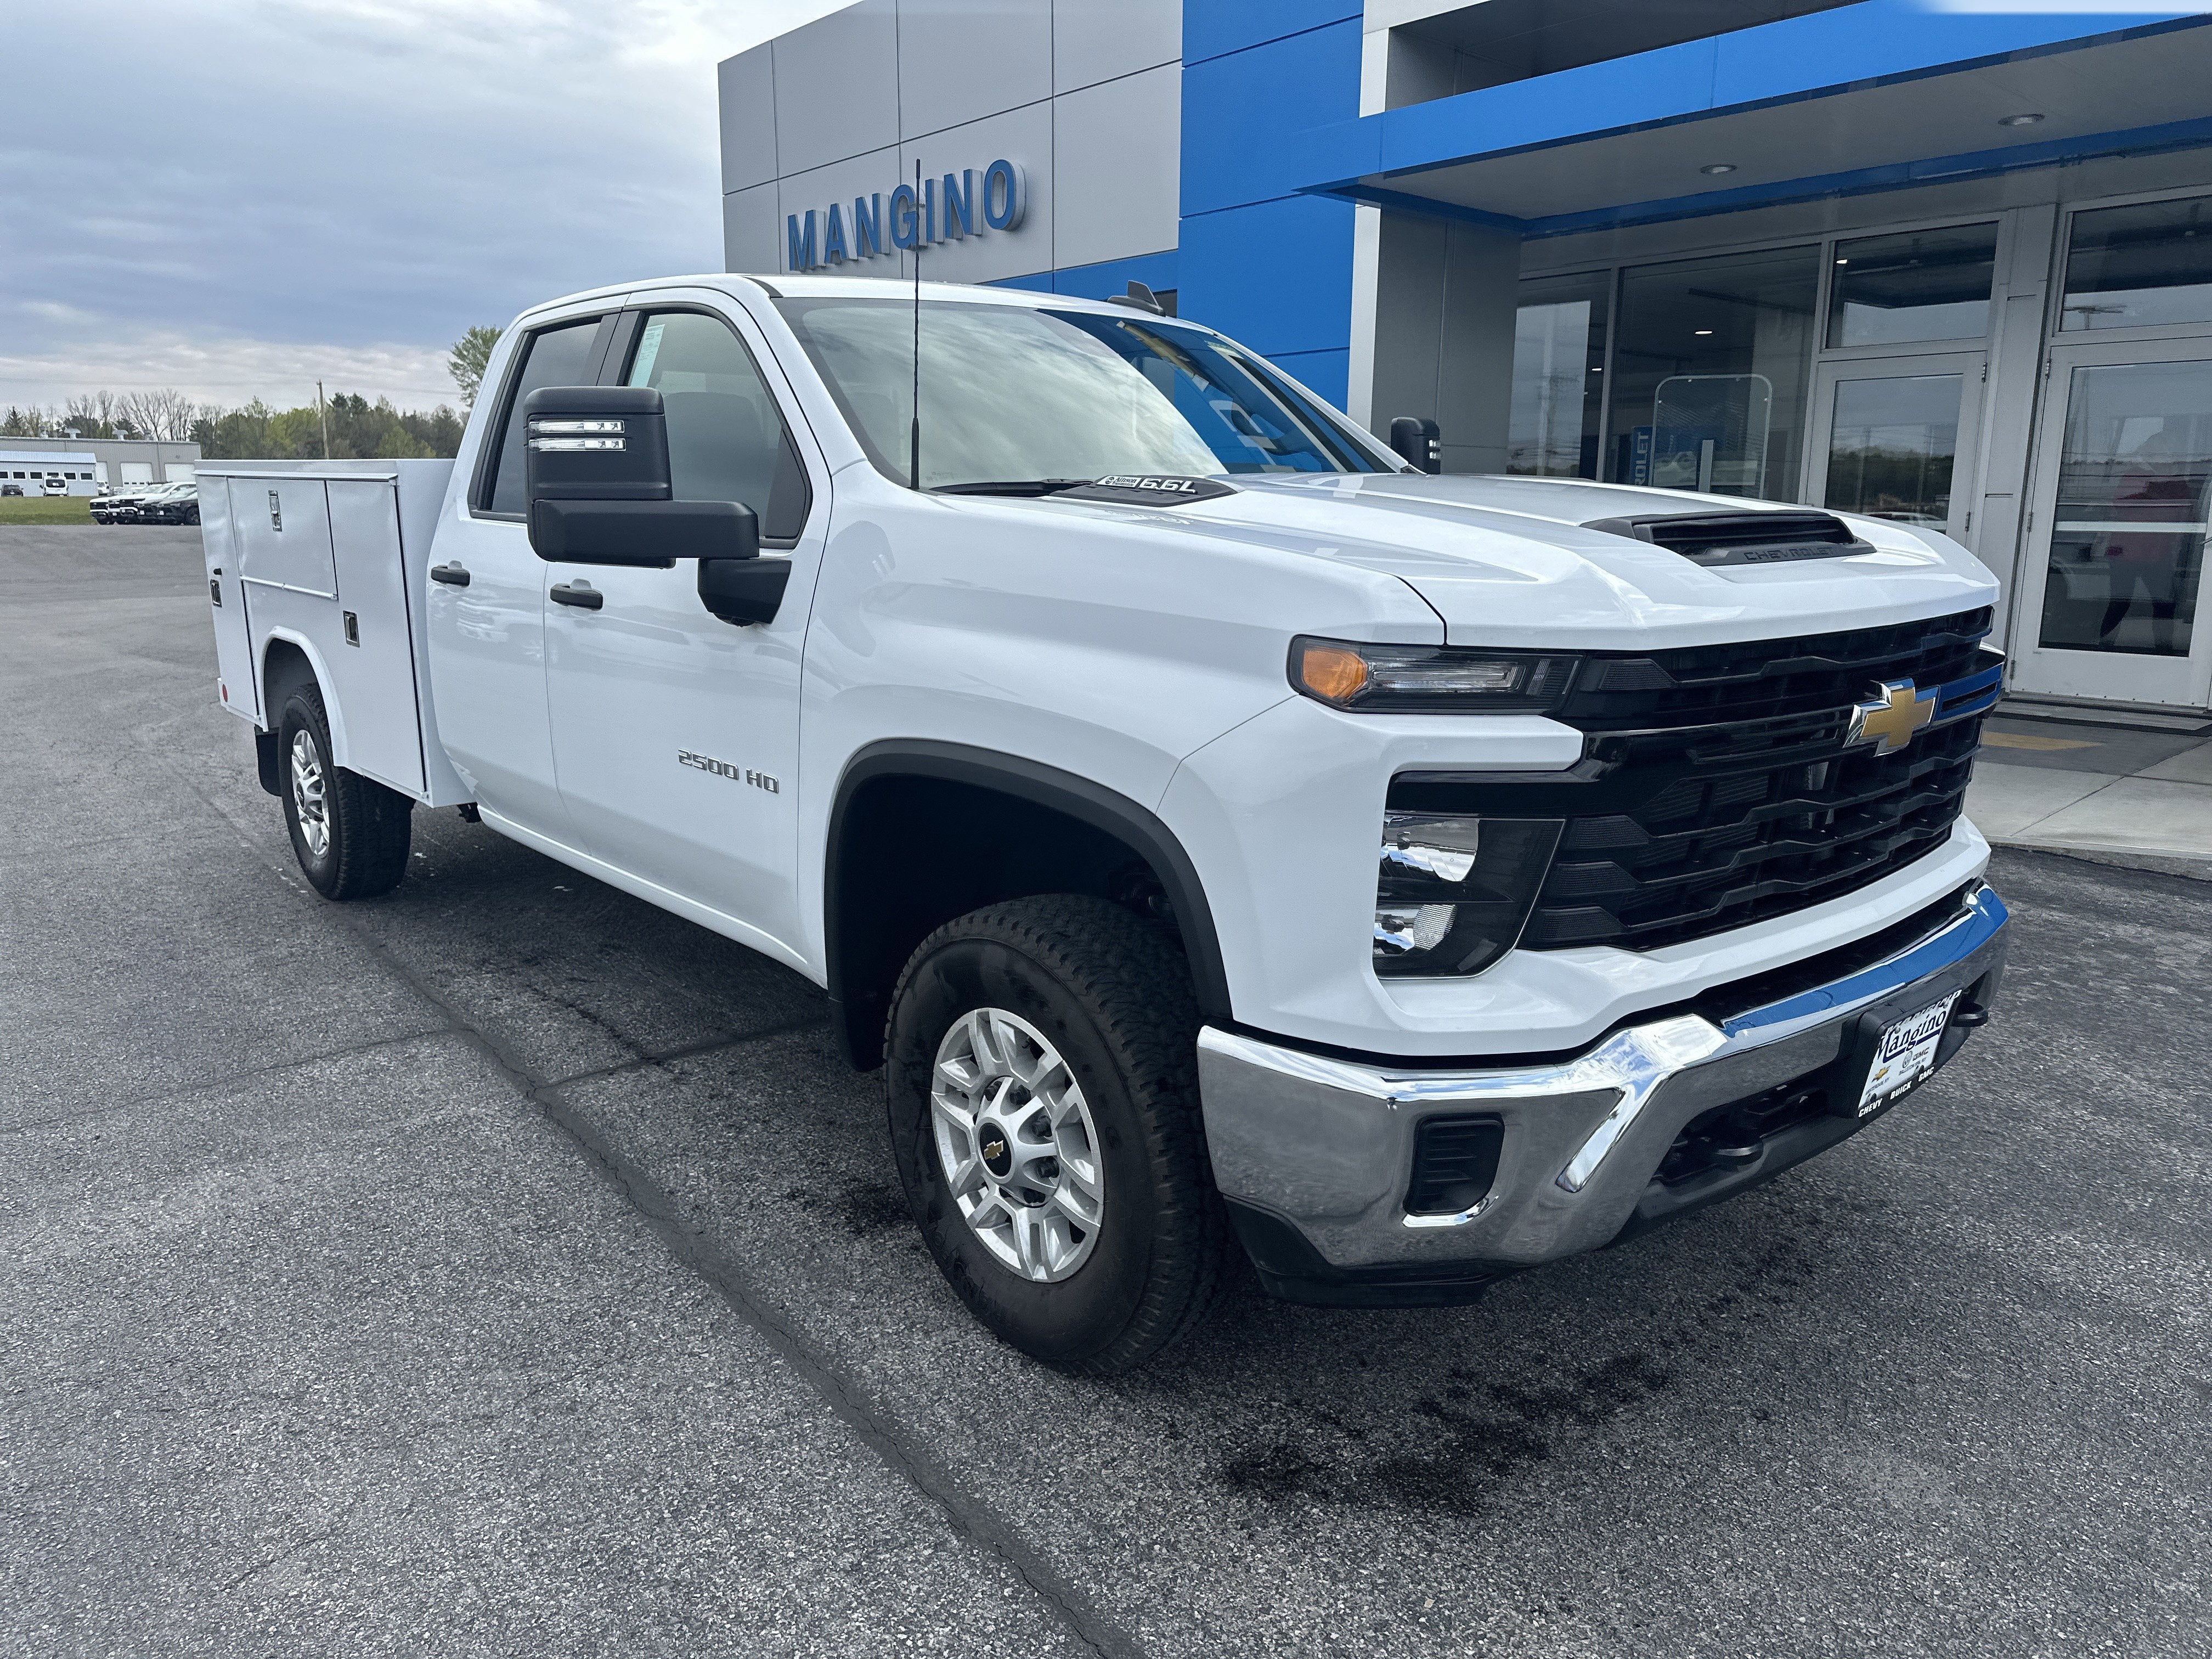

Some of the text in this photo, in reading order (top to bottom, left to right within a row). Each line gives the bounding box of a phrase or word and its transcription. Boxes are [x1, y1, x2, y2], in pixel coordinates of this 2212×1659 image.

[788, 159, 1020, 272] MANGINO
[1137, 478, 1197, 494] 6.6L
[1743, 546, 1833, 560] CHEVROLET
[678, 748, 780, 794] 2500 HD
[1877, 1010, 1947, 1063] Mangino
[1912, 1047, 1929, 1061] GMC
[1858, 1066, 1934, 1118] CHEVY BUICK GMC
